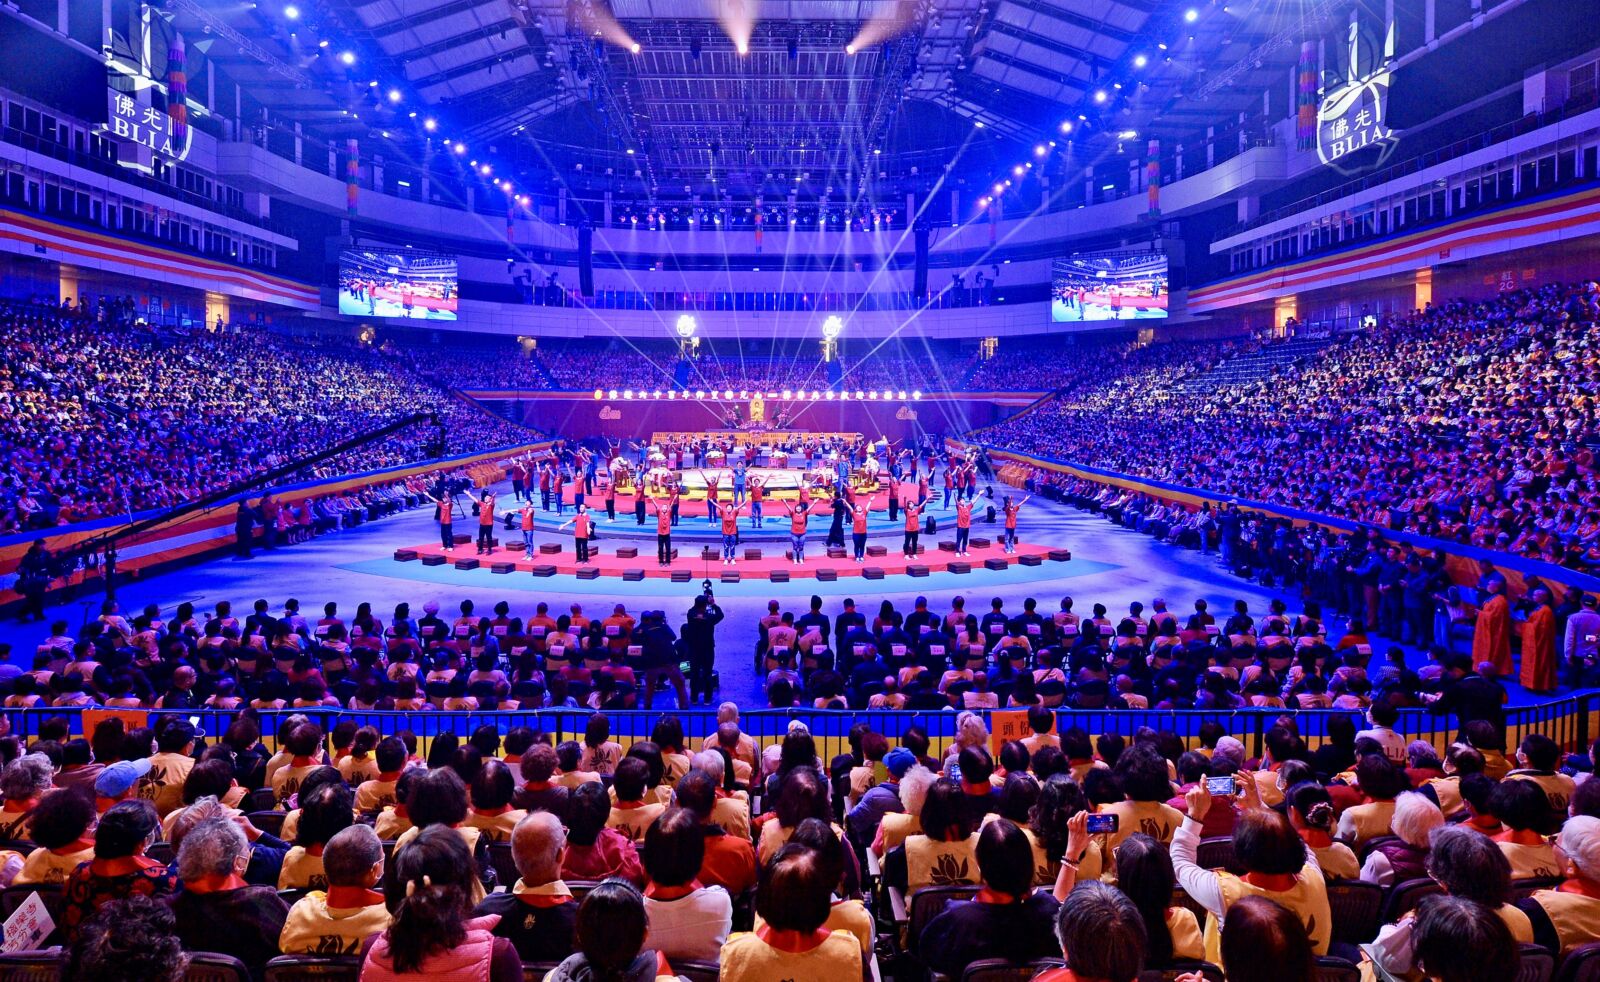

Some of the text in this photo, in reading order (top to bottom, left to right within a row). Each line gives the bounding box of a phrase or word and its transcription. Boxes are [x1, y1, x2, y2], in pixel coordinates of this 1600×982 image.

[115, 94, 162, 131] 佛光
[1330, 109, 1372, 140] 佛光
[113, 116, 176, 158] BLIA
[1330, 125, 1385, 160] BLIA
[1499, 281, 1514, 291] 2C
